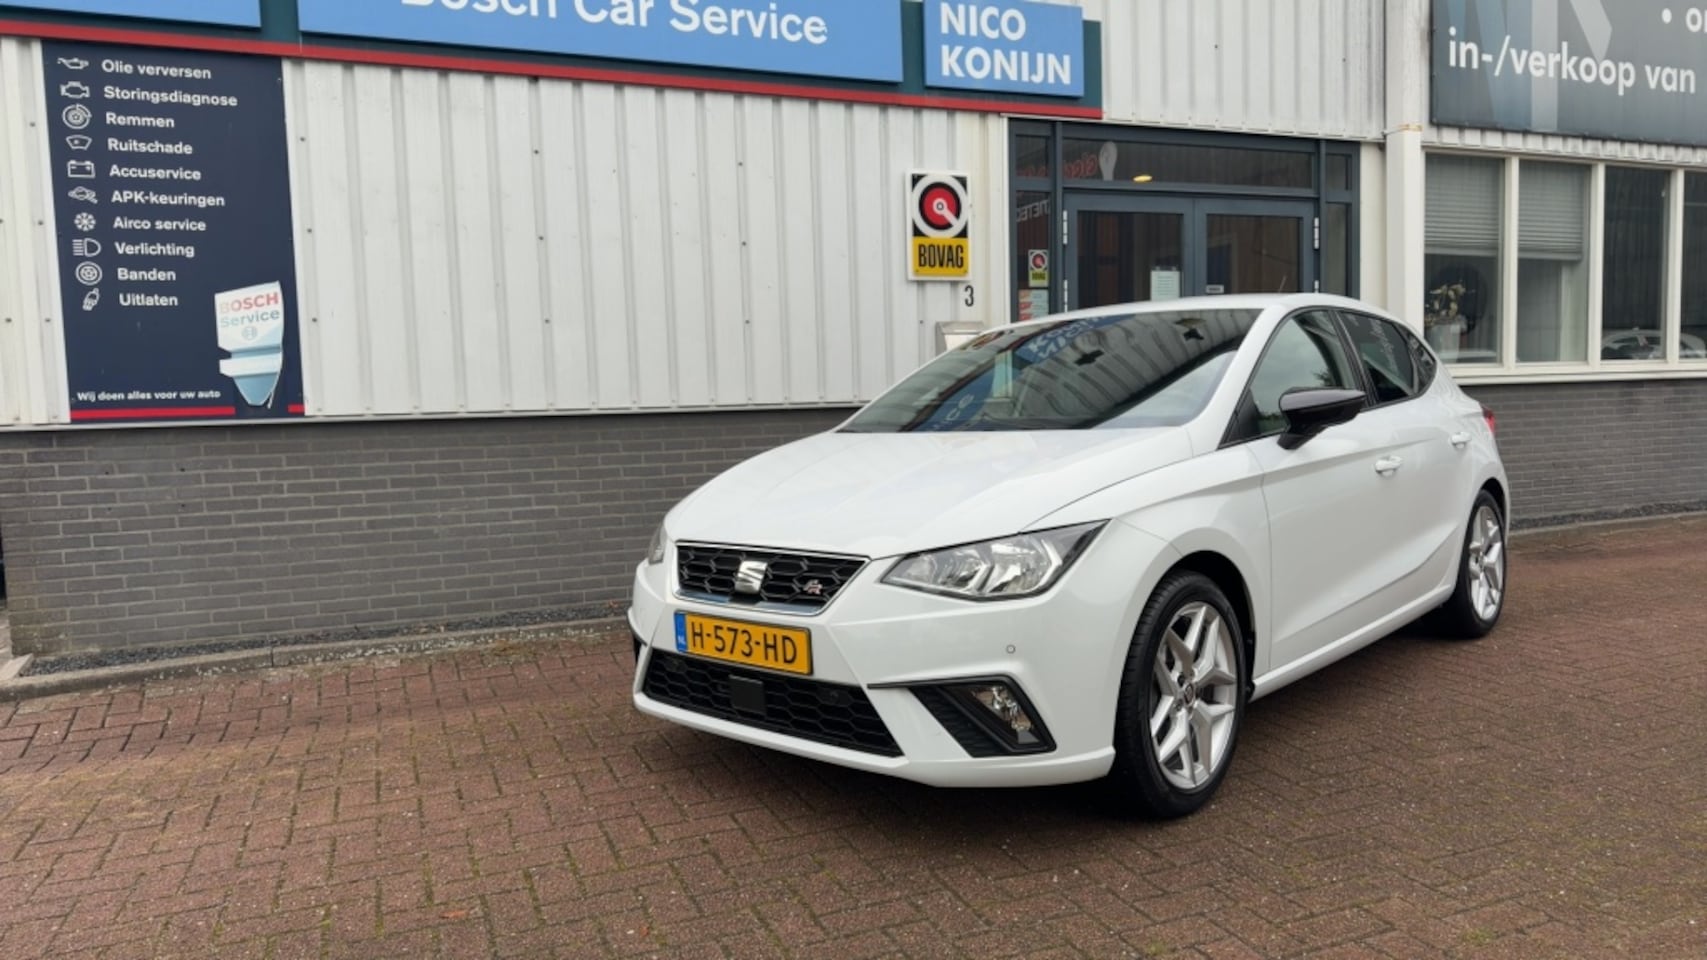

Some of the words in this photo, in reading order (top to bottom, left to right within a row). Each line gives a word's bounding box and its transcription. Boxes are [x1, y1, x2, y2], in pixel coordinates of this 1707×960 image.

[573, 0, 655, 27] Car
[669, 0, 828, 45] Service
[940, 2, 1026, 41] NICO
[1685, 7, 1707, 34] o
[101, 59, 133, 74] Olie
[137, 64, 211, 79] verversen
[941, 44, 1071, 85] KONIJN
[1449, 26, 1636, 96] in-/verkoop
[1645, 64, 1696, 94] van
[103, 85, 238, 106] Storingsdiagnose
[105, 112, 175, 128] Remmen
[107, 137, 193, 154] Ruitschade
[109, 164, 202, 180] Accuservice
[111, 190, 226, 208] APK-keuringen
[113, 216, 151, 230] Airco
[154, 218, 207, 231] service
[114, 241, 195, 258] Verlichting
[918, 243, 964, 268] BOVAG
[117, 267, 177, 281] Banden
[119, 293, 179, 307] Uitlaten
[220, 291, 279, 313] BOSCH
[964, 284, 974, 307] 3
[220, 310, 280, 328] Service
[77, 391, 96, 402] Wij
[97, 391, 125, 401] doen
[127, 391, 152, 400] alles
[154, 391, 178, 400] voor
[180, 391, 195, 399] uw
[198, 389, 221, 399] auto
[691, 621, 797, 664] H-573-HD
